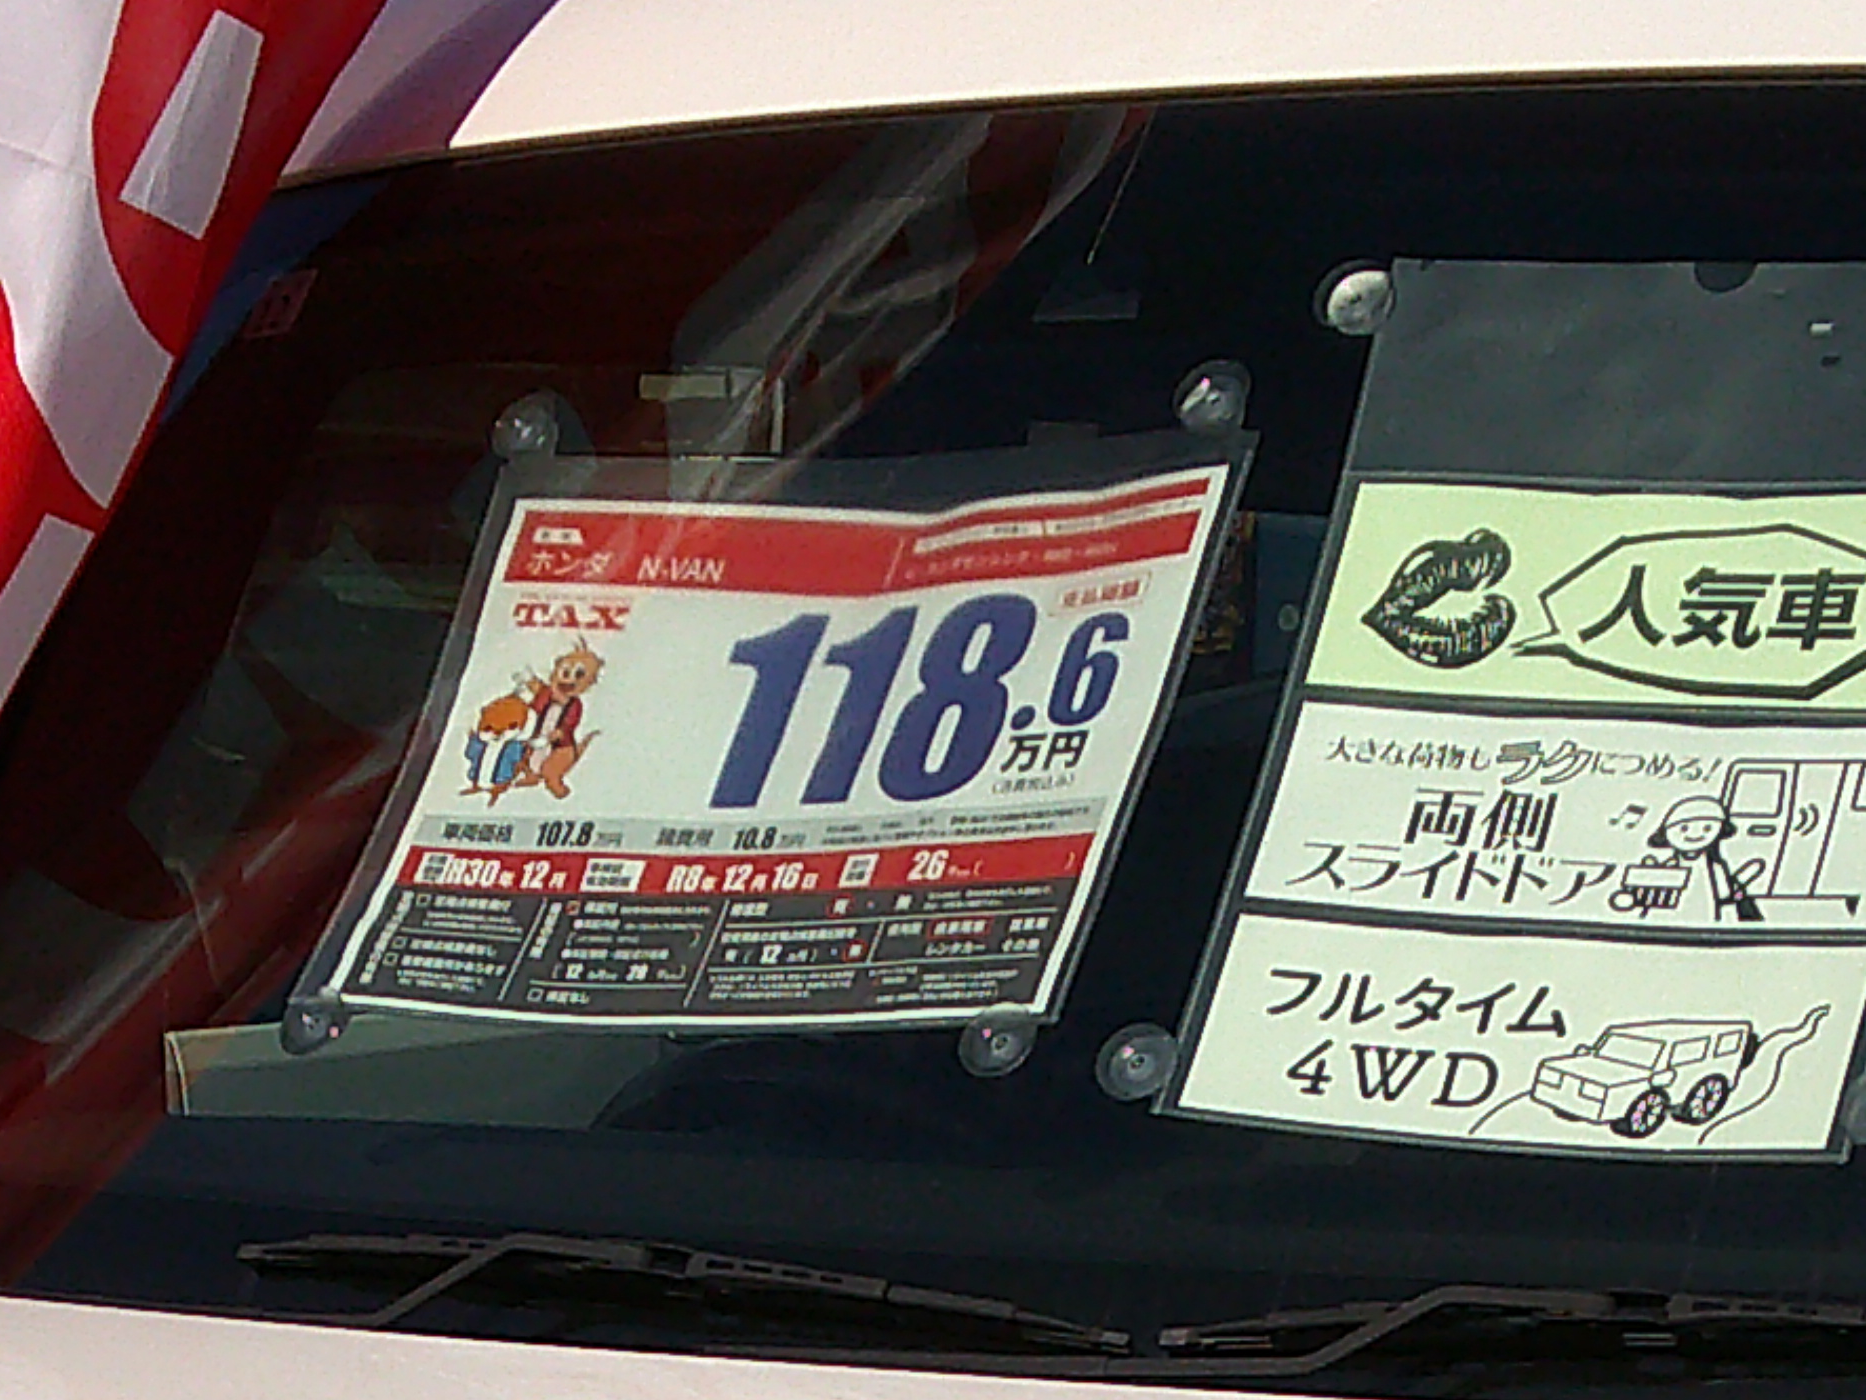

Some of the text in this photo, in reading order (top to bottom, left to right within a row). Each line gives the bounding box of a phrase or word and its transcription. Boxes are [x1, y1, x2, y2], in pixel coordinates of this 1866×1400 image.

[526, 551, 613, 579] ホンダ
[512, 602, 630, 630] TAX
[1001, 729, 1089, 773] 万円
[1403, 787, 1560, 853] 両側
[1287, 841, 1618, 906] スライドドア
[1265, 967, 1567, 1038] フルタイム
[1285, 1038, 1500, 1108] 4WD
